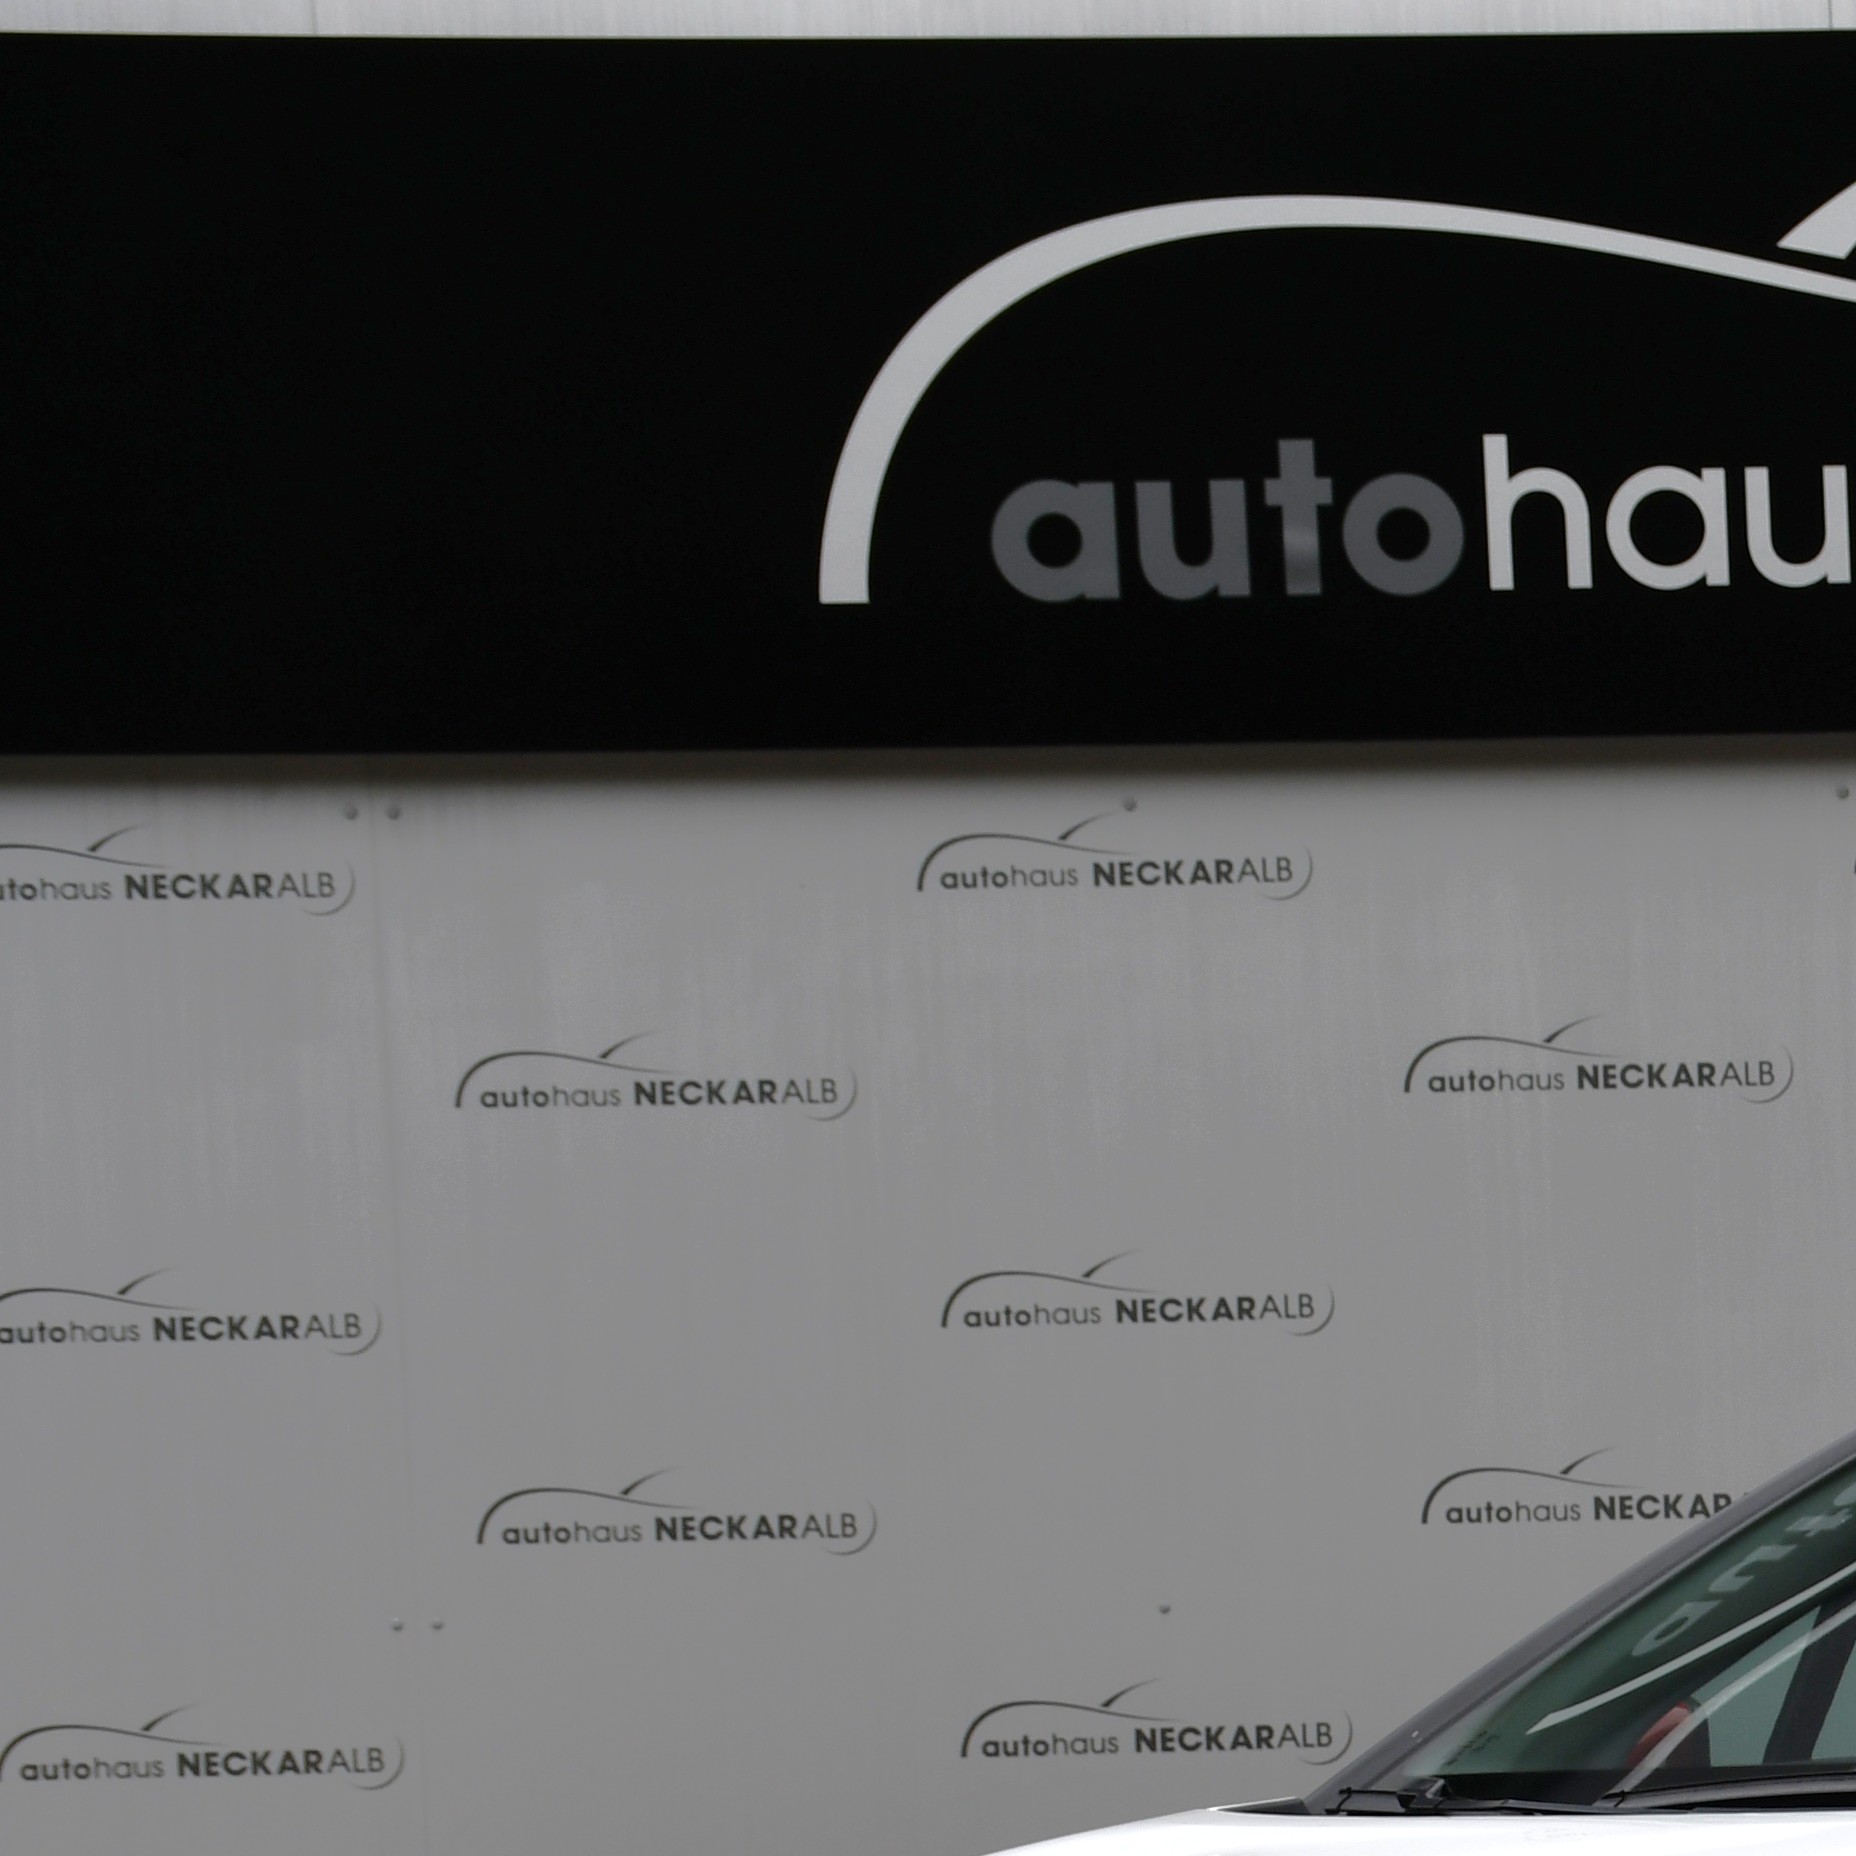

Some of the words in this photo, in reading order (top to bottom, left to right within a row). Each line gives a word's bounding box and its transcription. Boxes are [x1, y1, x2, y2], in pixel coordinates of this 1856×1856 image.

[124, 872, 335, 900] NECKARALB
[940, 866, 1078, 889] autohaus
[1093, 857, 1292, 887] NECKARALB
[1428, 1070, 1564, 1092] autohaus
[1577, 1061, 1775, 1090] NECKARALB
[480, 1086, 621, 1108] autohaus
[634, 1078, 837, 1106] NECKARALB
[963, 1304, 1101, 1328] autohaus
[1116, 1293, 1314, 1324] NECKARALB
[0, 1322, 140, 1344] autohaus
[153, 1313, 361, 1341] NECKARALB
[1446, 1501, 1581, 1524] autohaus
[502, 1522, 642, 1545] autohaus
[655, 1513, 857, 1542] NECKARALB
[982, 1734, 1119, 1758] autohaus
[1135, 1722, 1332, 1753] NECKARALB
[20, 1758, 164, 1781] autohaus
[177, 1748, 384, 1777] NECKARALB
